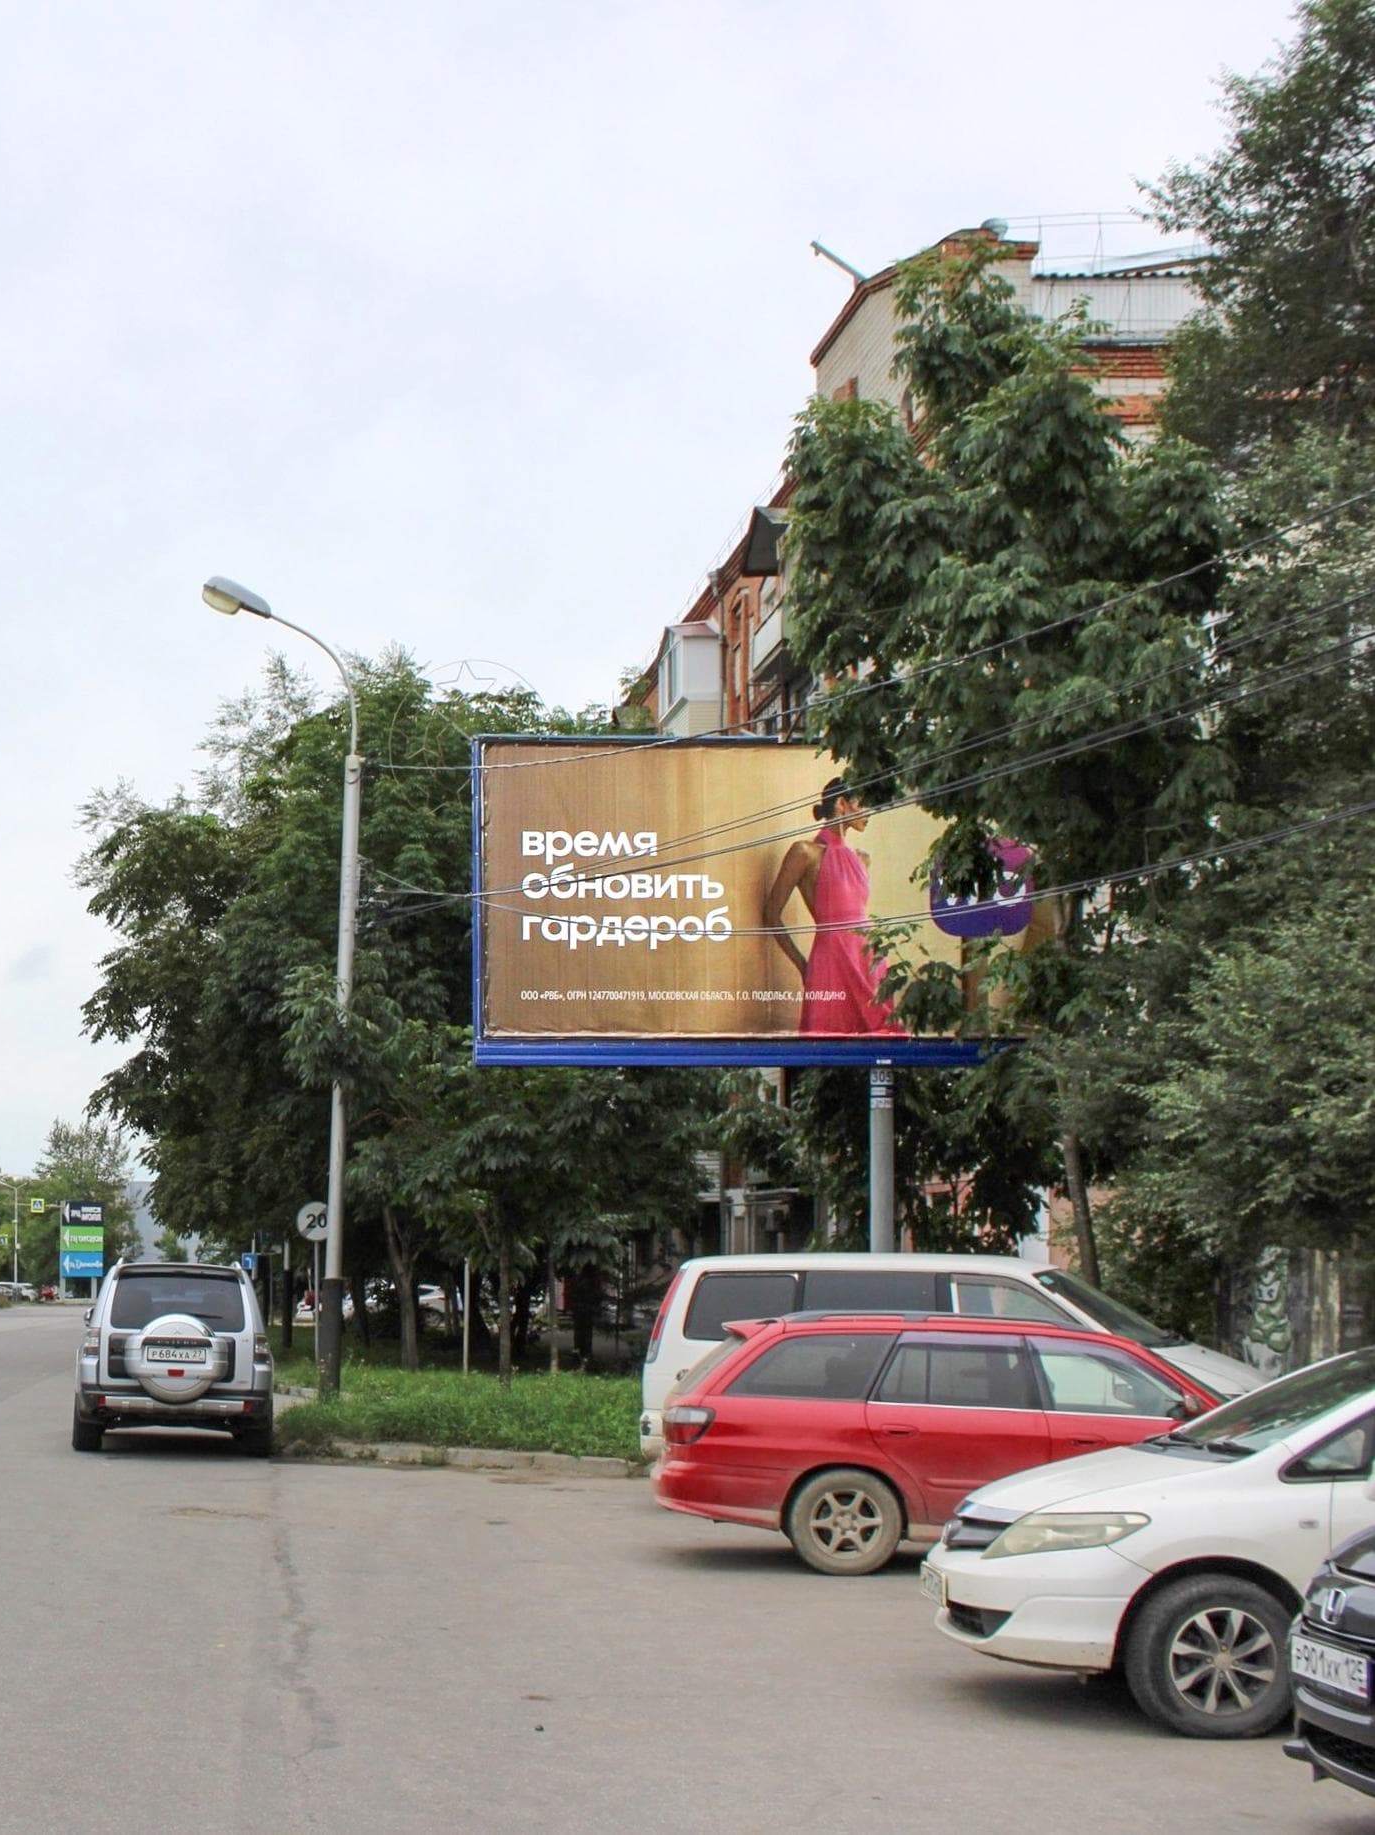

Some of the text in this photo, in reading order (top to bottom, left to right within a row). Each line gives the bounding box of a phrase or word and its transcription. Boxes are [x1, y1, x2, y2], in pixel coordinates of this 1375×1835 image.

[521, 830, 658, 865] время
[521, 862, 725, 900] обновить
[521, 905, 733, 950] гардероб
[520, 990, 539, 1001] ООО
[567, 990, 587, 1001] ОГРН
[648, 990, 699, 1001] МОСКОВСКАЯ
[805, 990, 847, 1002] КОЛЕДИНО
[306, 1213, 328, 1229] 20
